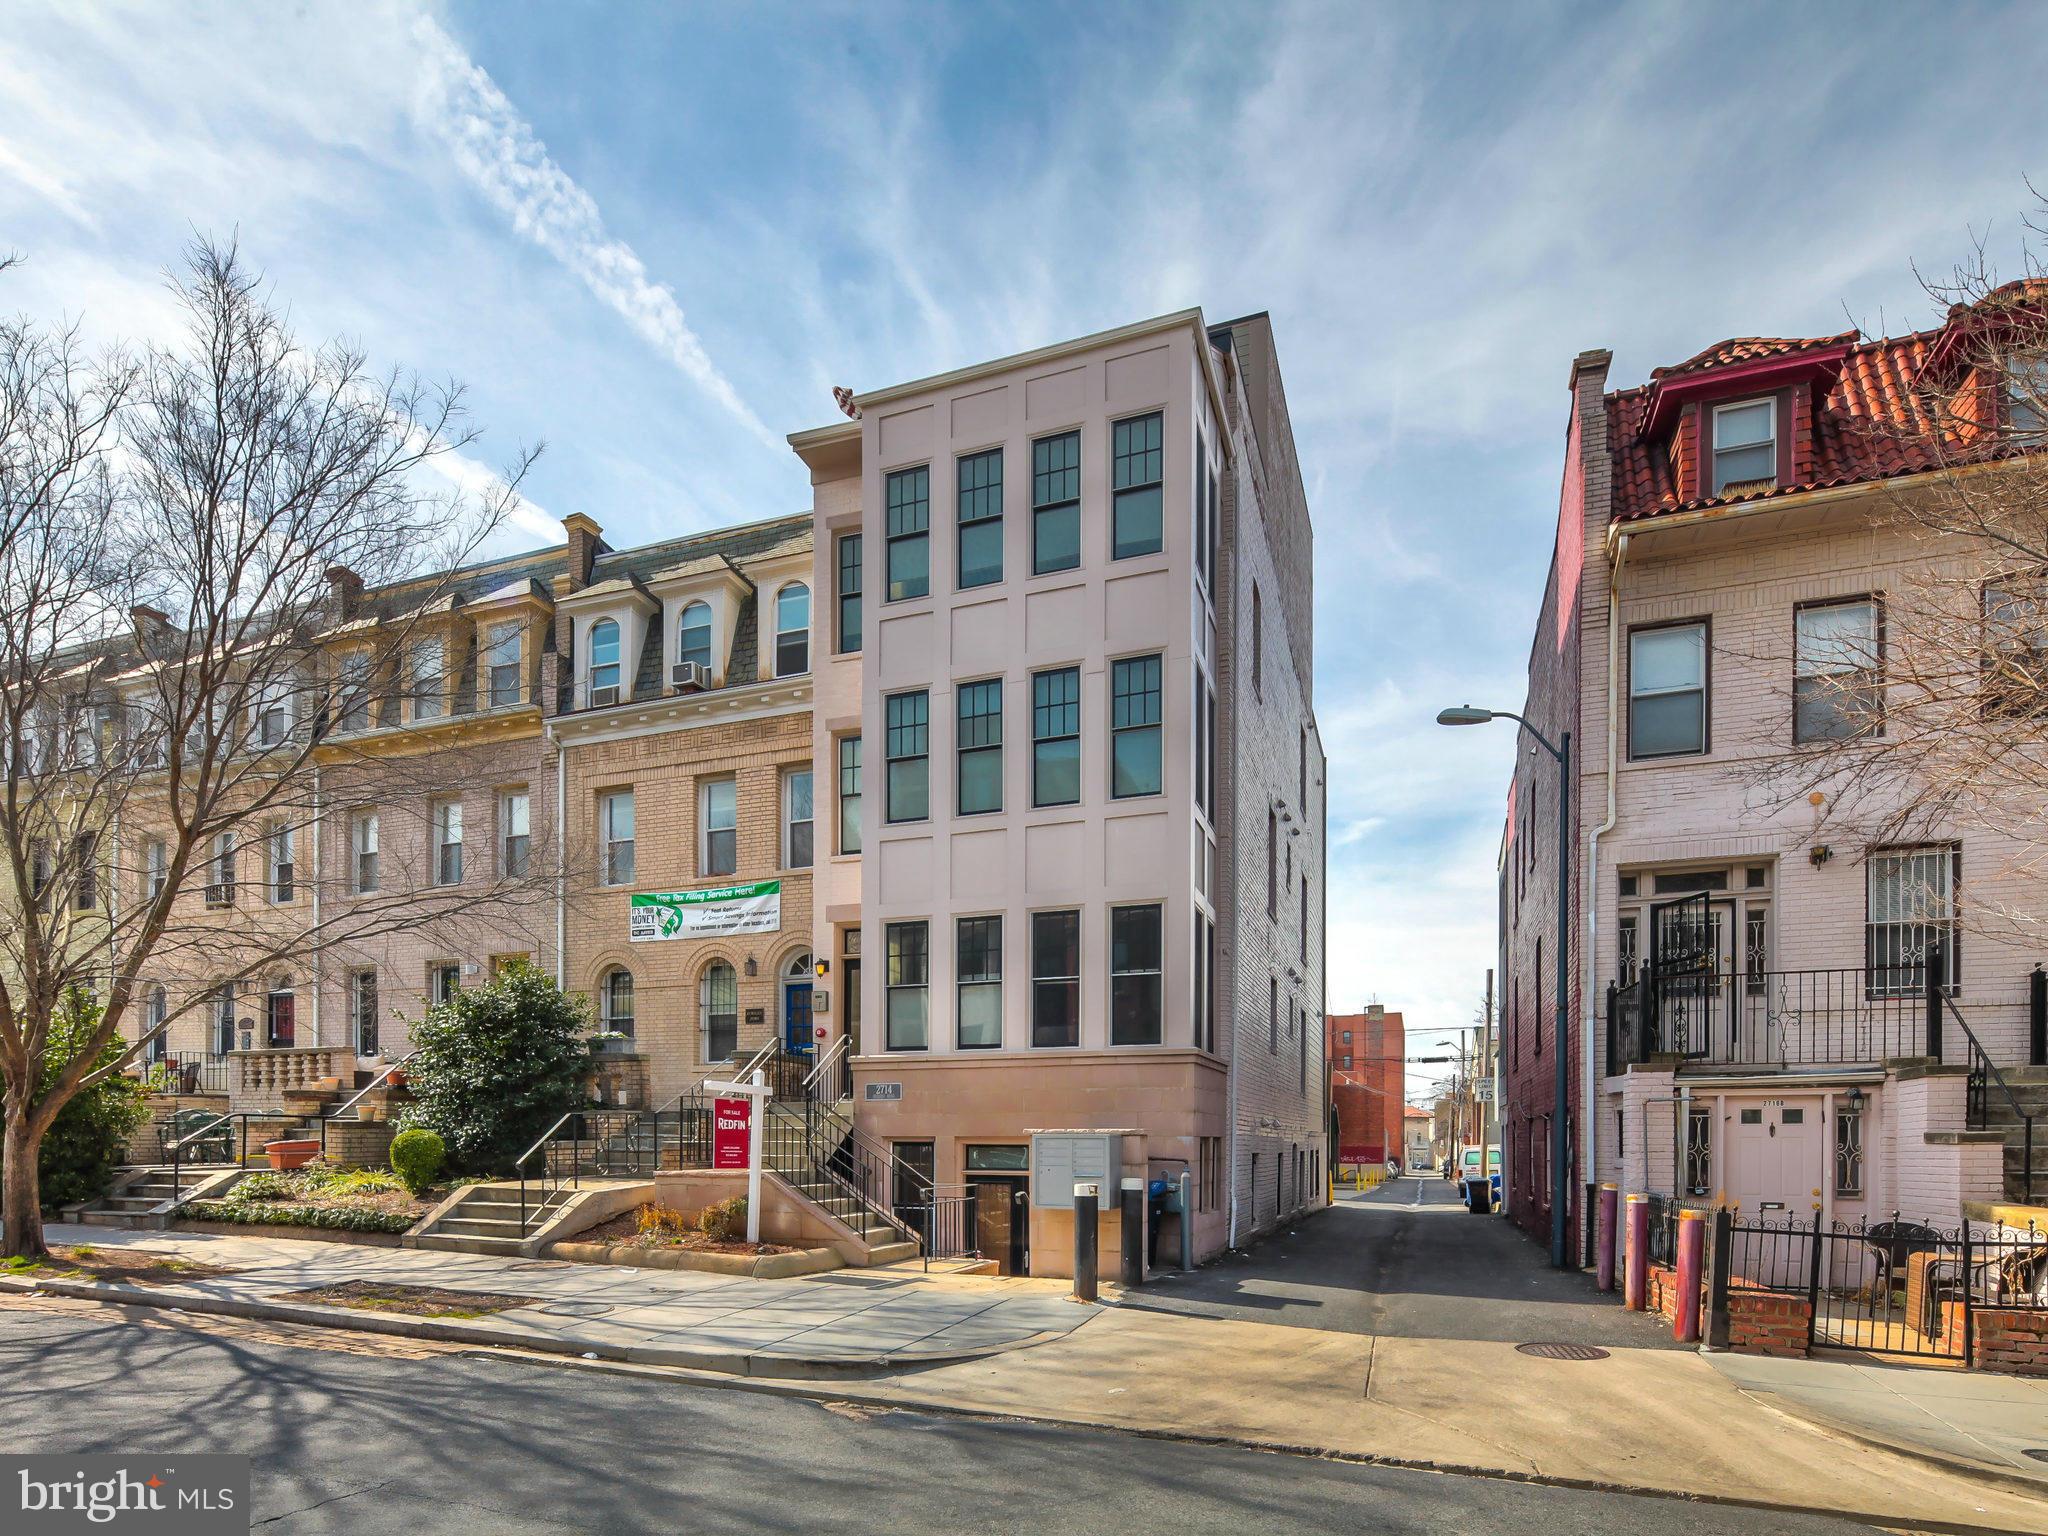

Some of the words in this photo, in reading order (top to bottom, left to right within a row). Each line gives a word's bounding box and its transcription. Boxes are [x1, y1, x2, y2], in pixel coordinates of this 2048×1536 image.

[656, 895, 671, 903] Free
[673, 893, 684, 901] Tax
[706, 889, 733, 899] Service
[735, 886, 755, 896] Here!
[746, 909, 777, 917] Information
[632, 914, 655, 925] MONEY
[876, 1085, 892, 1095] 2714
[1479, 1090, 1493, 1100] 15
[718, 1117, 746, 1130] REDFIN
